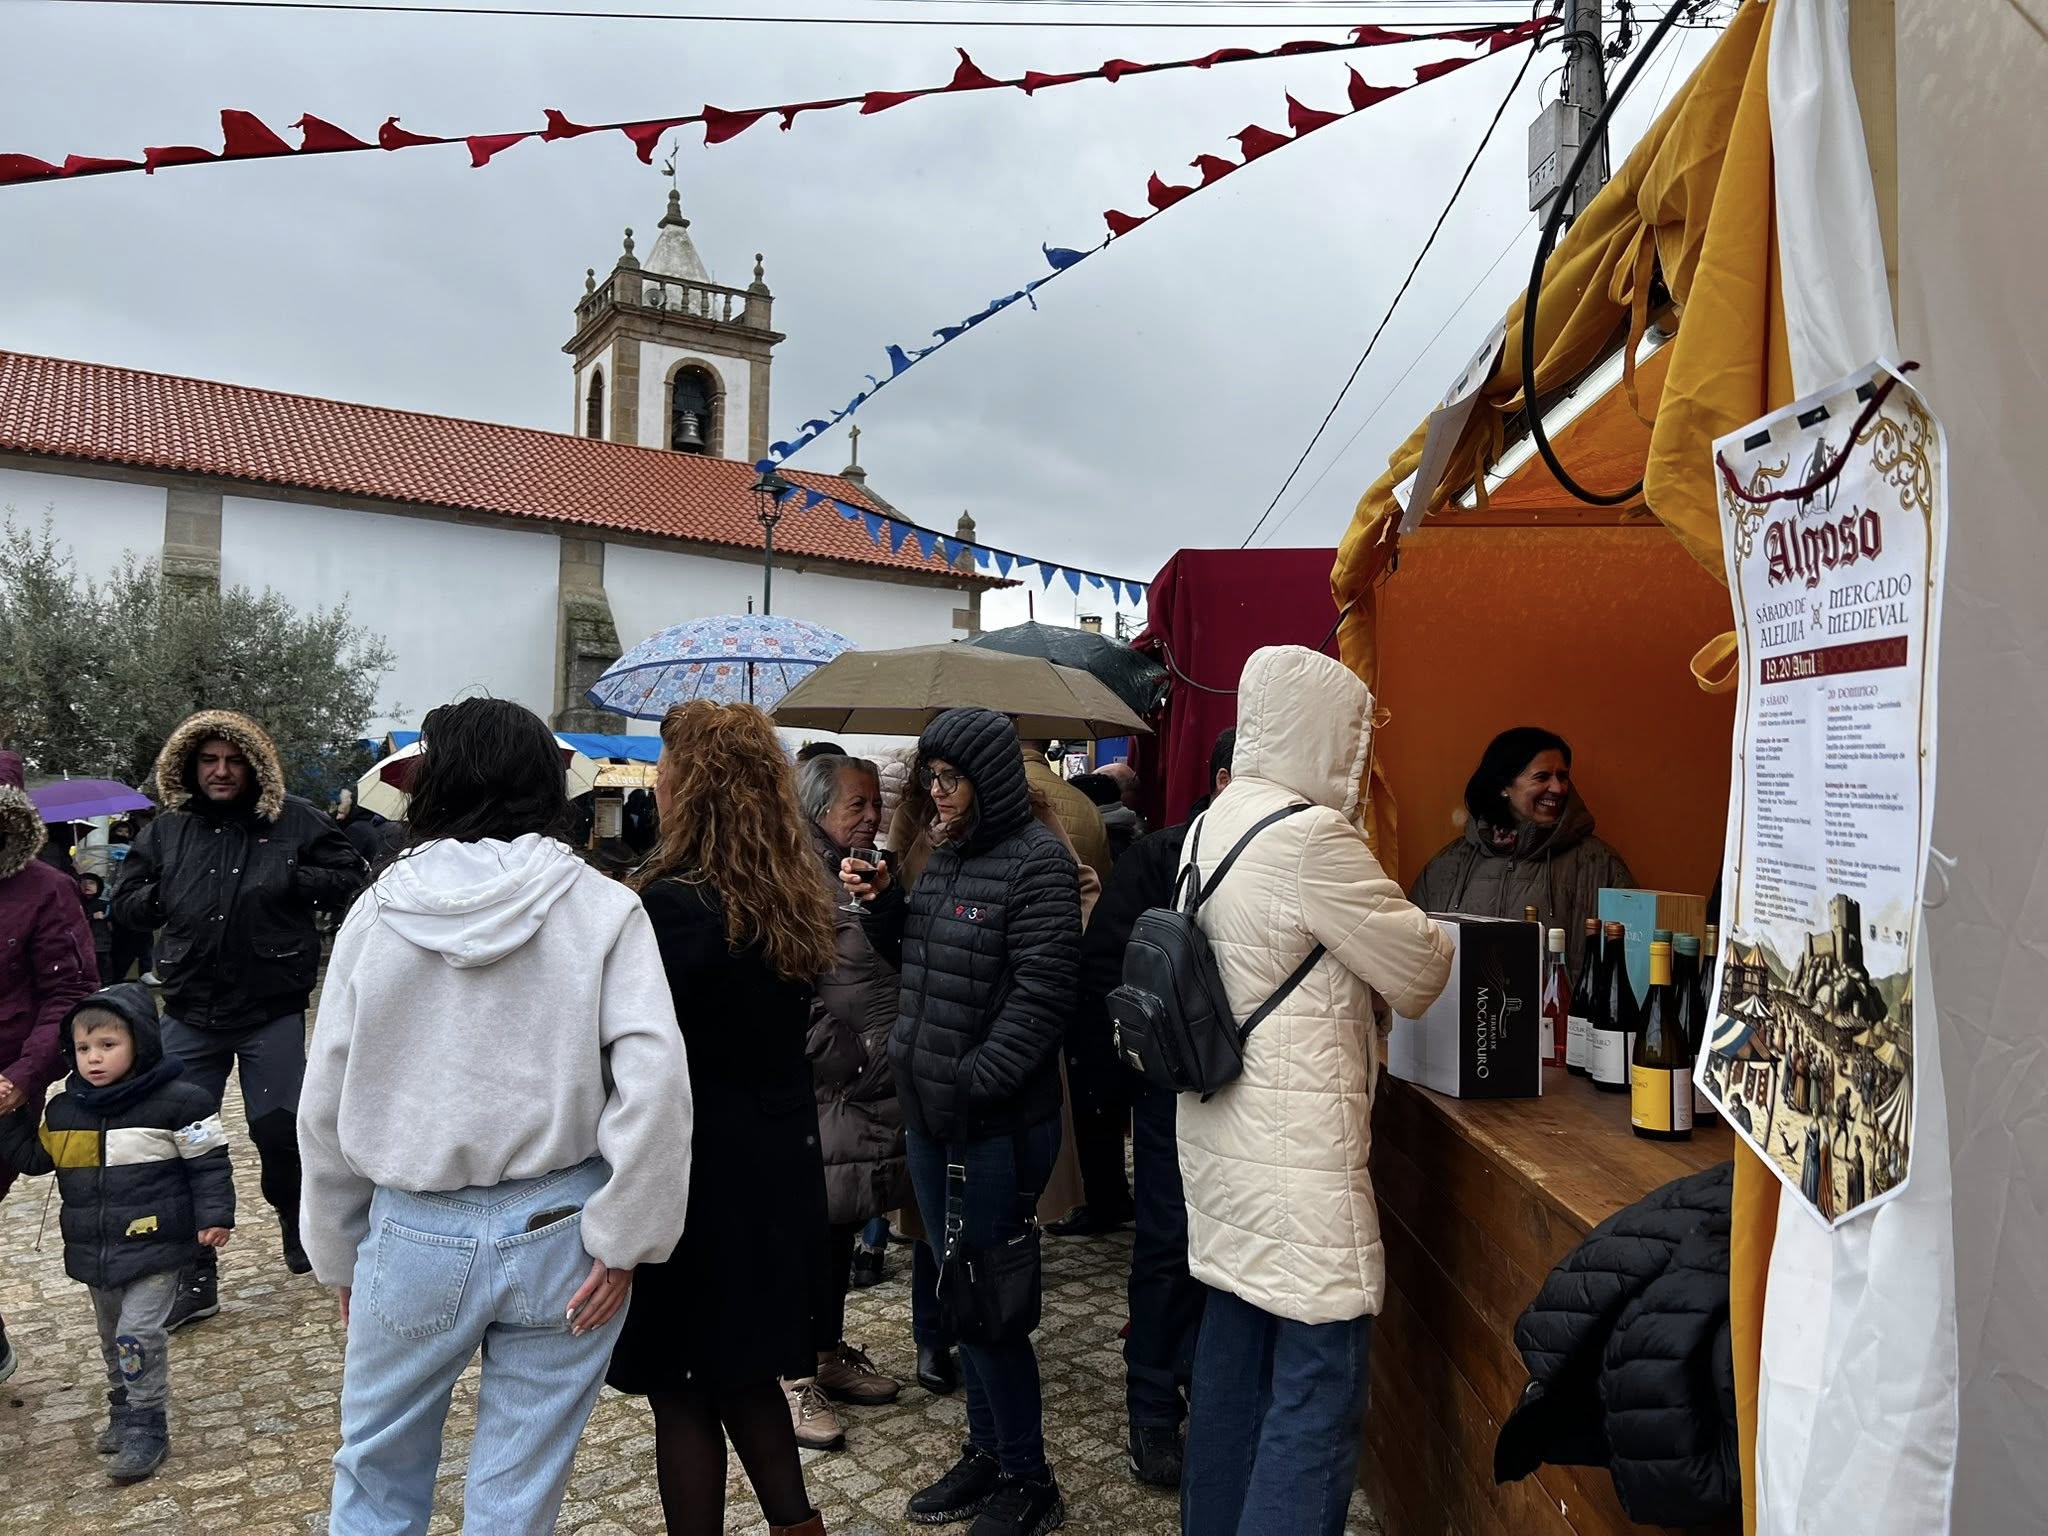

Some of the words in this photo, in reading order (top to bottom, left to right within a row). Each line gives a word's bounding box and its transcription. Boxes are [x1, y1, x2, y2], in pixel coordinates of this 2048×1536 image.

[1763, 505, 1882, 589] Algoso
[1829, 573, 1911, 609] MERCADO
[1755, 600, 1793, 624] SÁBADO
[1794, 597, 1806, 614] DE
[1828, 602, 1909, 635] MEDIEVAL
[1760, 620, 1805, 648] ALELUIA
[1838, 685, 1879, 699] DOMINGO
[1476, 986, 1489, 1079] MOGADOURO
